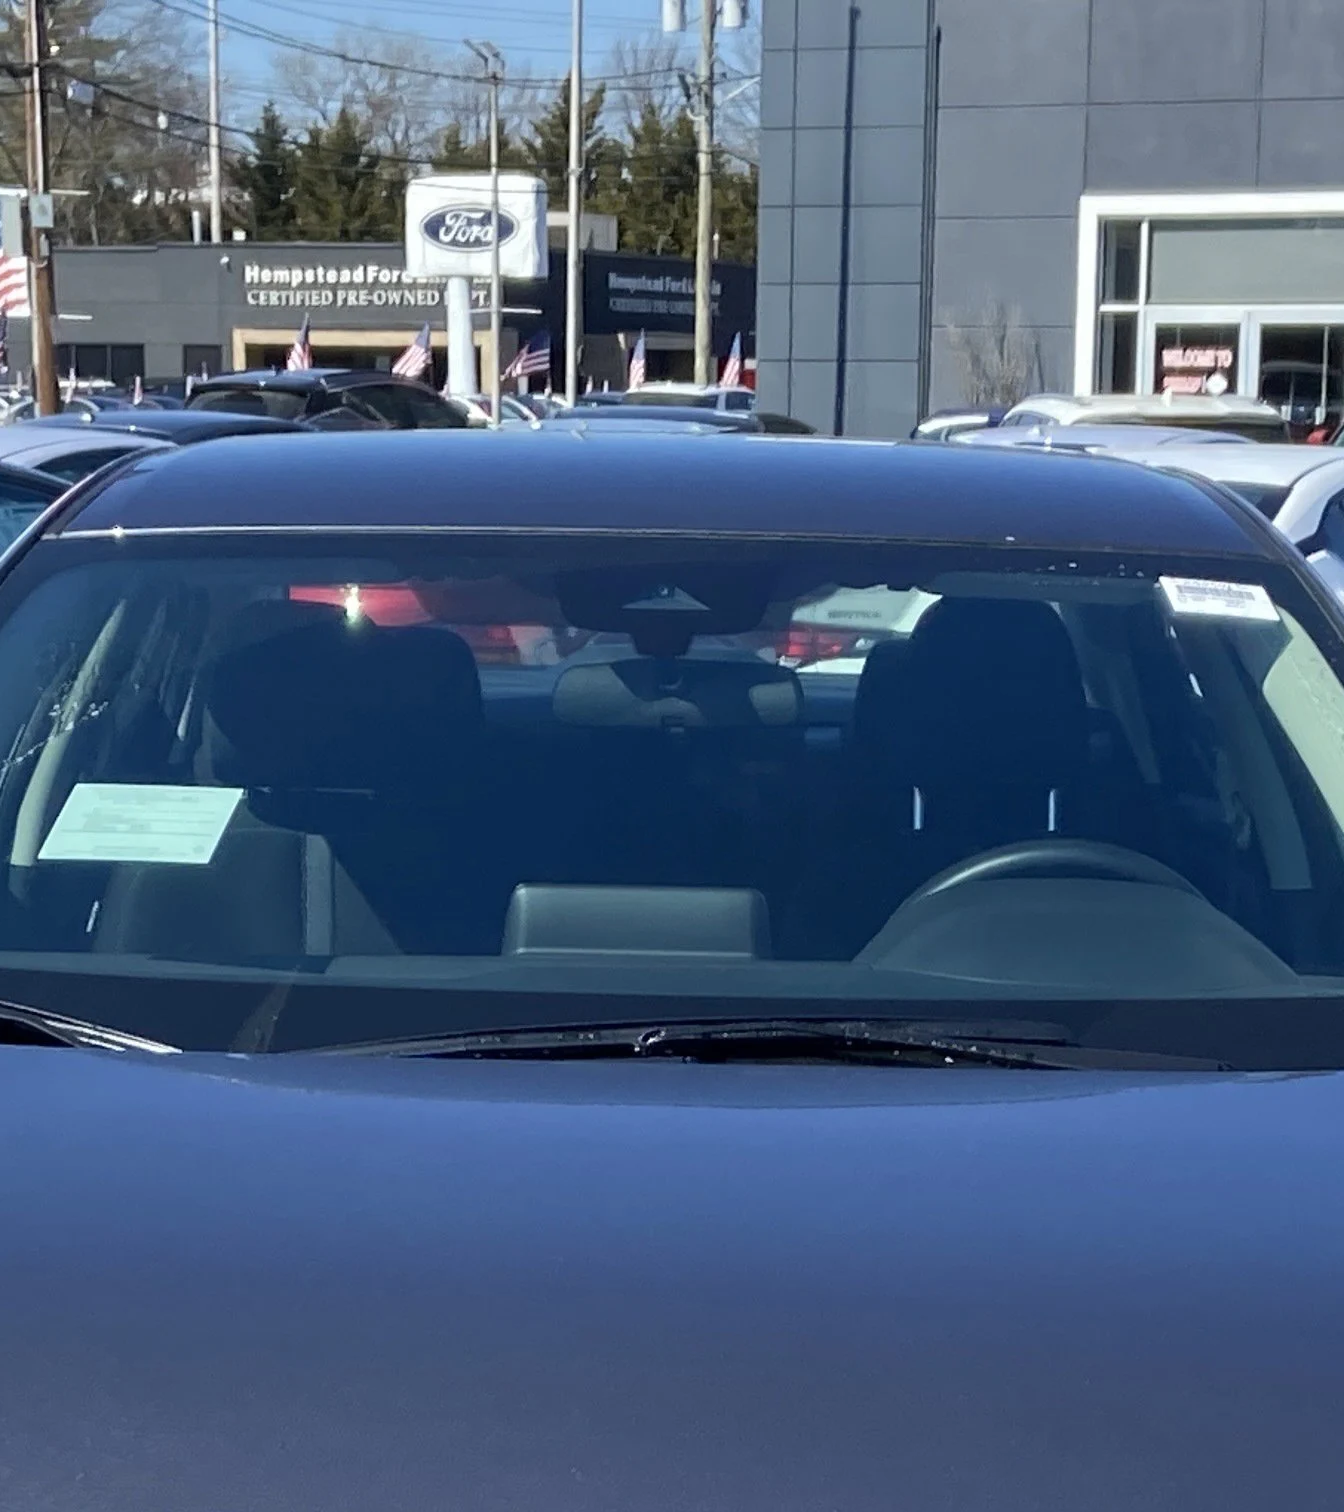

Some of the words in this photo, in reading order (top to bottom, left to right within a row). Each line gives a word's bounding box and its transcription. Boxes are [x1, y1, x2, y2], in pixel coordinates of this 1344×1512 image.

[244, 263, 365, 287] Hempstead
[247, 289, 333, 306] CERTIFIED
[337, 289, 440, 306] PRE-OWNED
